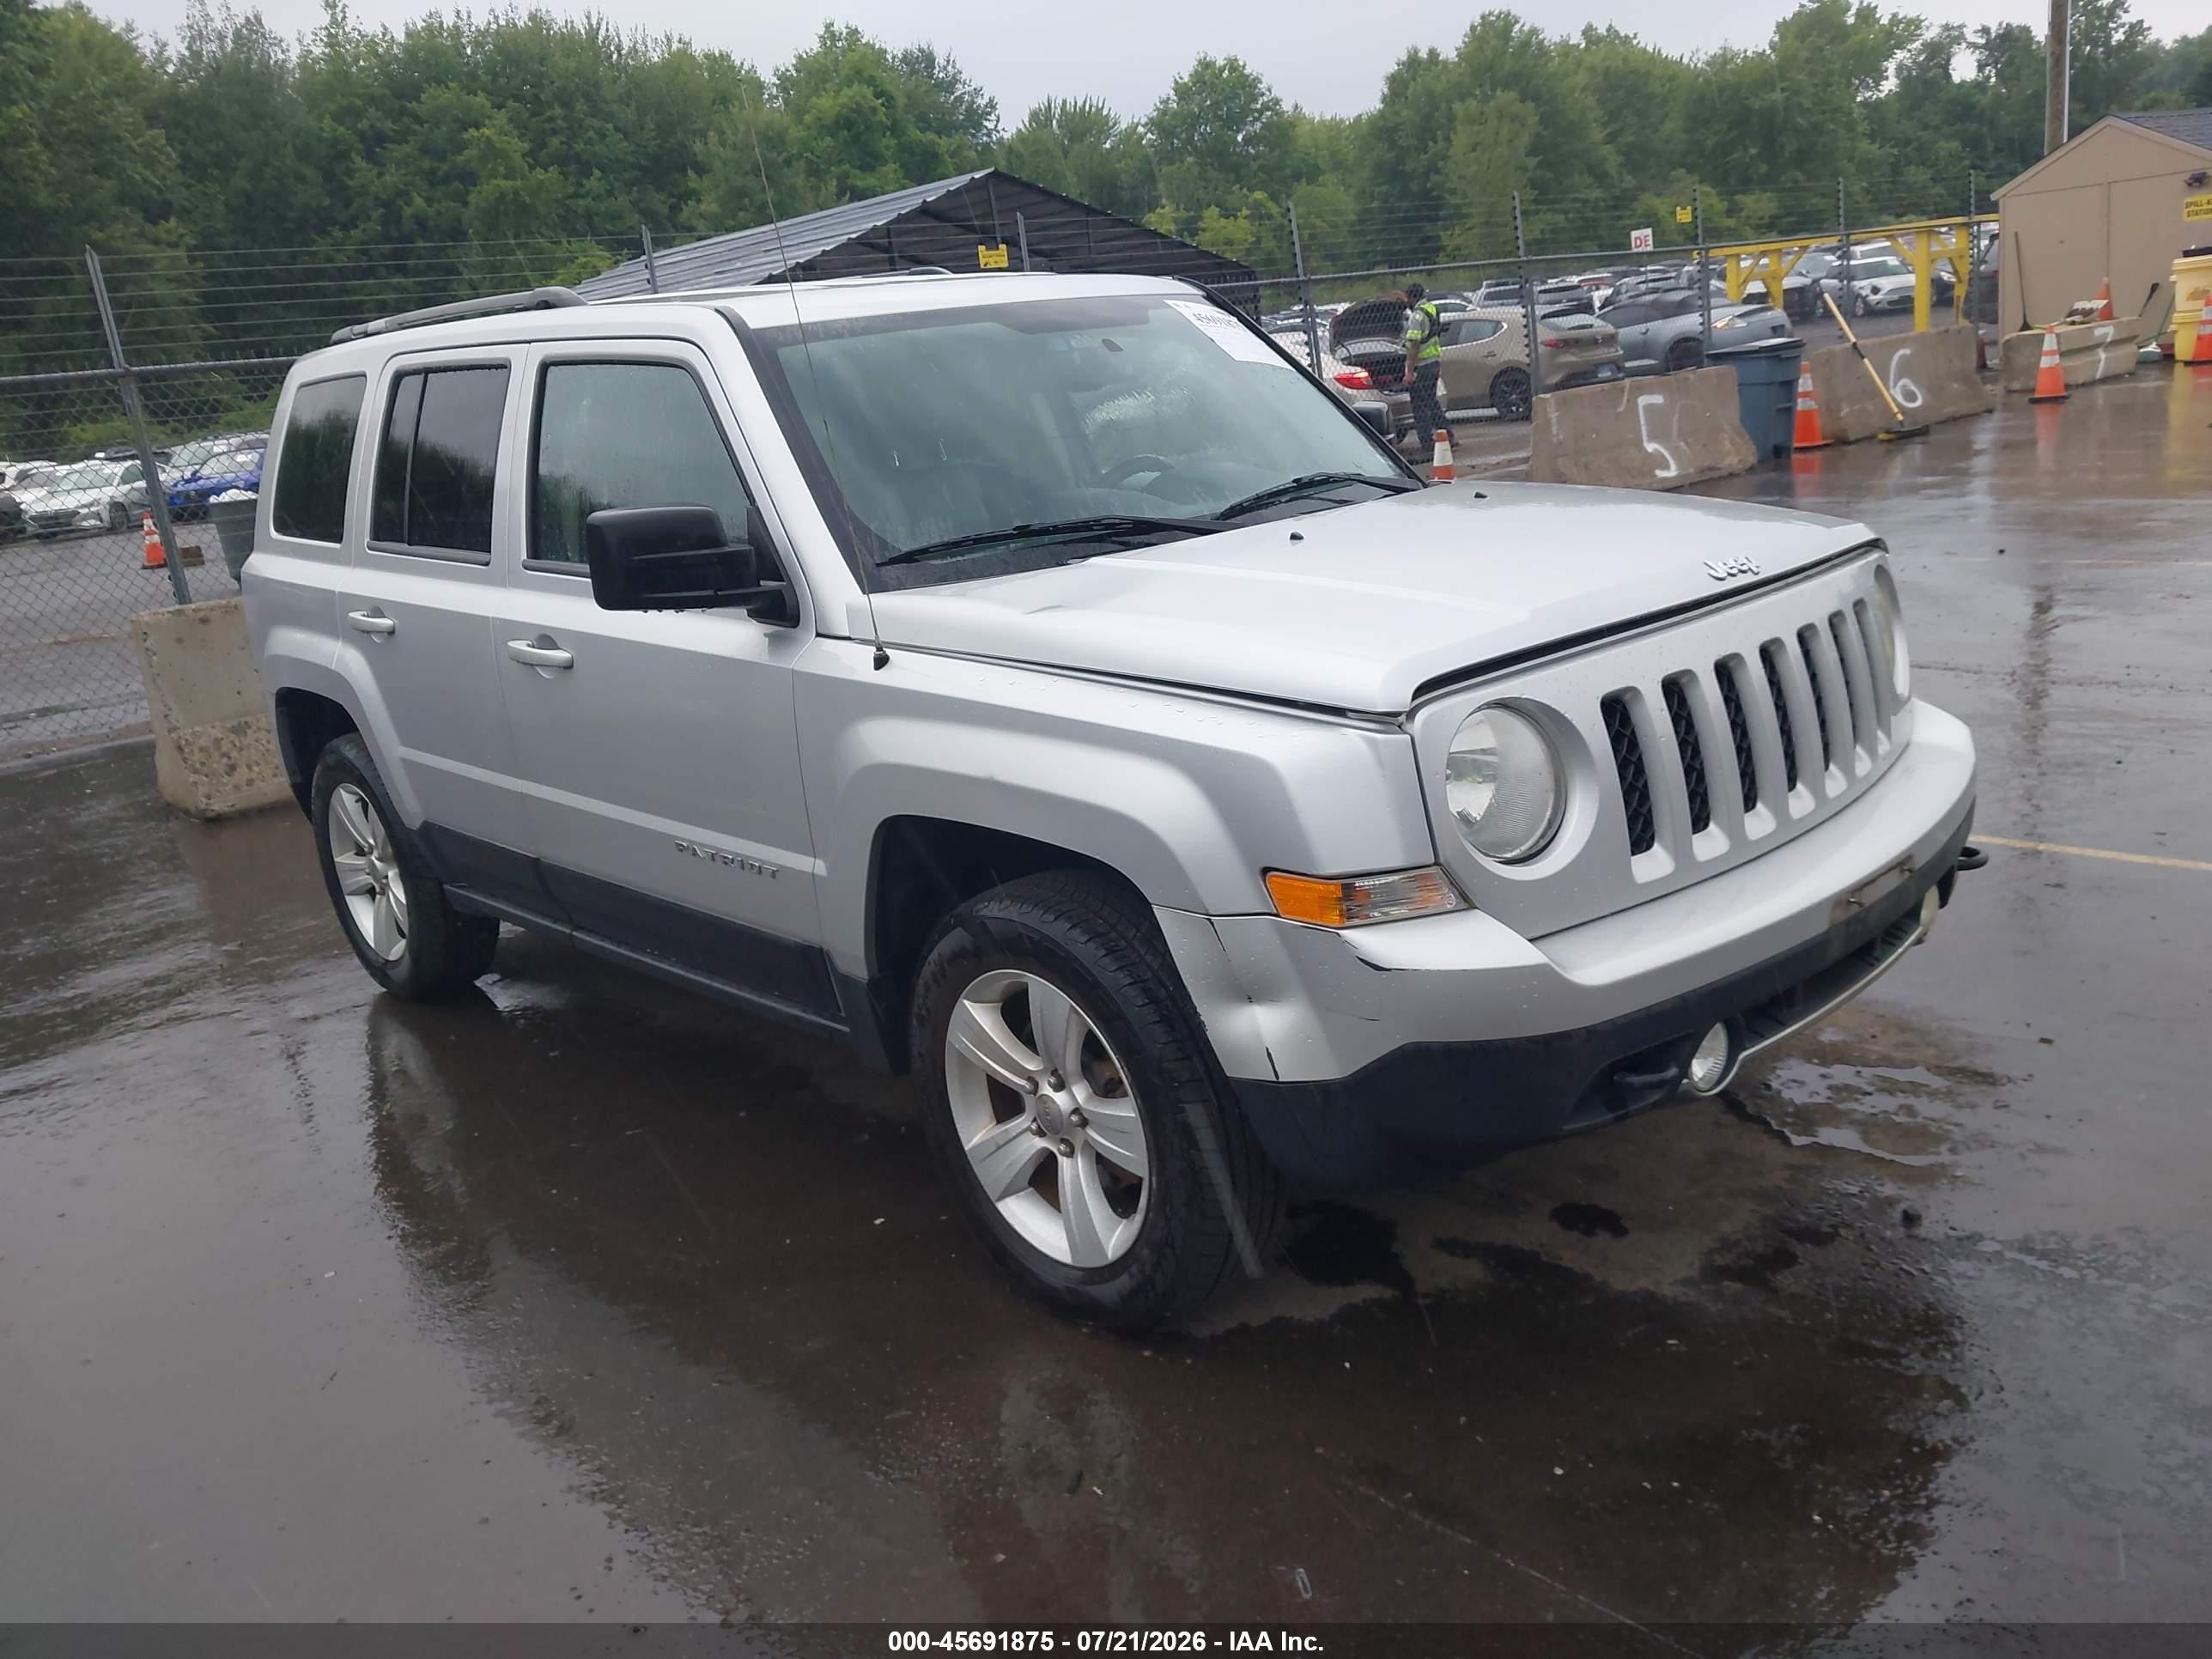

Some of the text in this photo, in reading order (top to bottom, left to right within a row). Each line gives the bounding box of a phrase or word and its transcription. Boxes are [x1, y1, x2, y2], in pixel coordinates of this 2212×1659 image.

[1634, 234, 1650, 248] DE
[2094, 325, 2114, 380] 7
[1889, 348, 1923, 408] 6
[1638, 394, 1679, 477] 5
[1704, 556, 1759, 581] Jeep
[674, 840, 779, 879] PATRIOT
